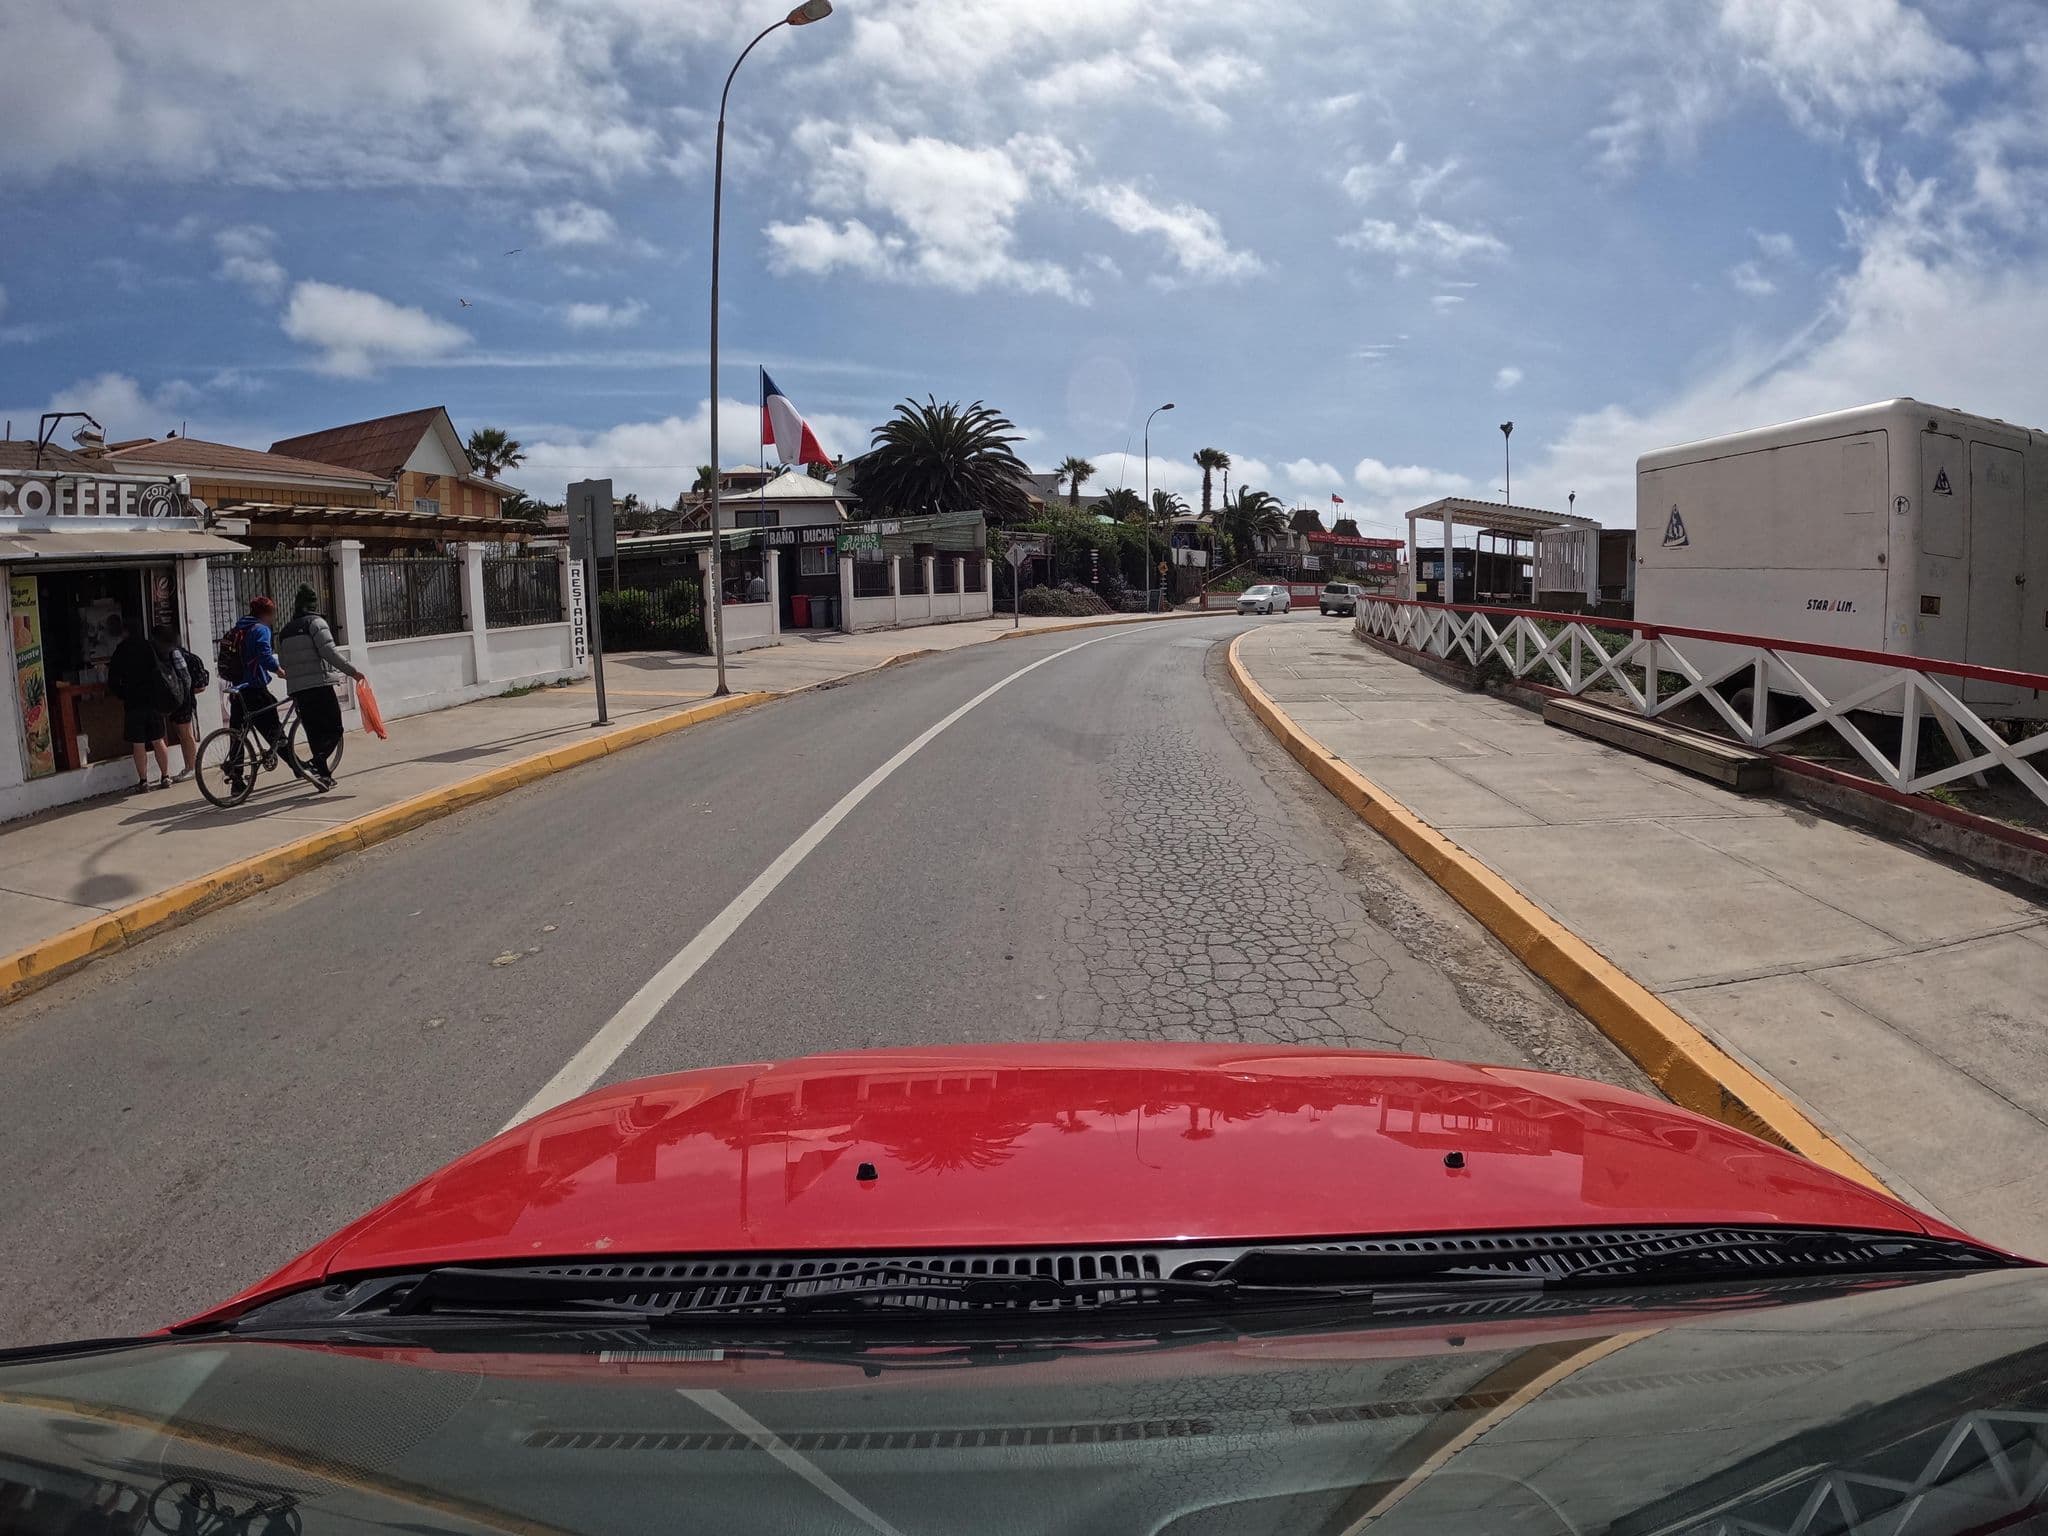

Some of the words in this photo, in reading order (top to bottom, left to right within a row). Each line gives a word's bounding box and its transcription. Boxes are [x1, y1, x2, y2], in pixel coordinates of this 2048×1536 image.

[146, 487, 173, 501] COSTA
[769, 528, 795, 545] BAÑO
[840, 541, 880, 552] DUCHAS
[1806, 599, 1829, 611] STAR
[571, 568, 585, 665] RESTAURANT
